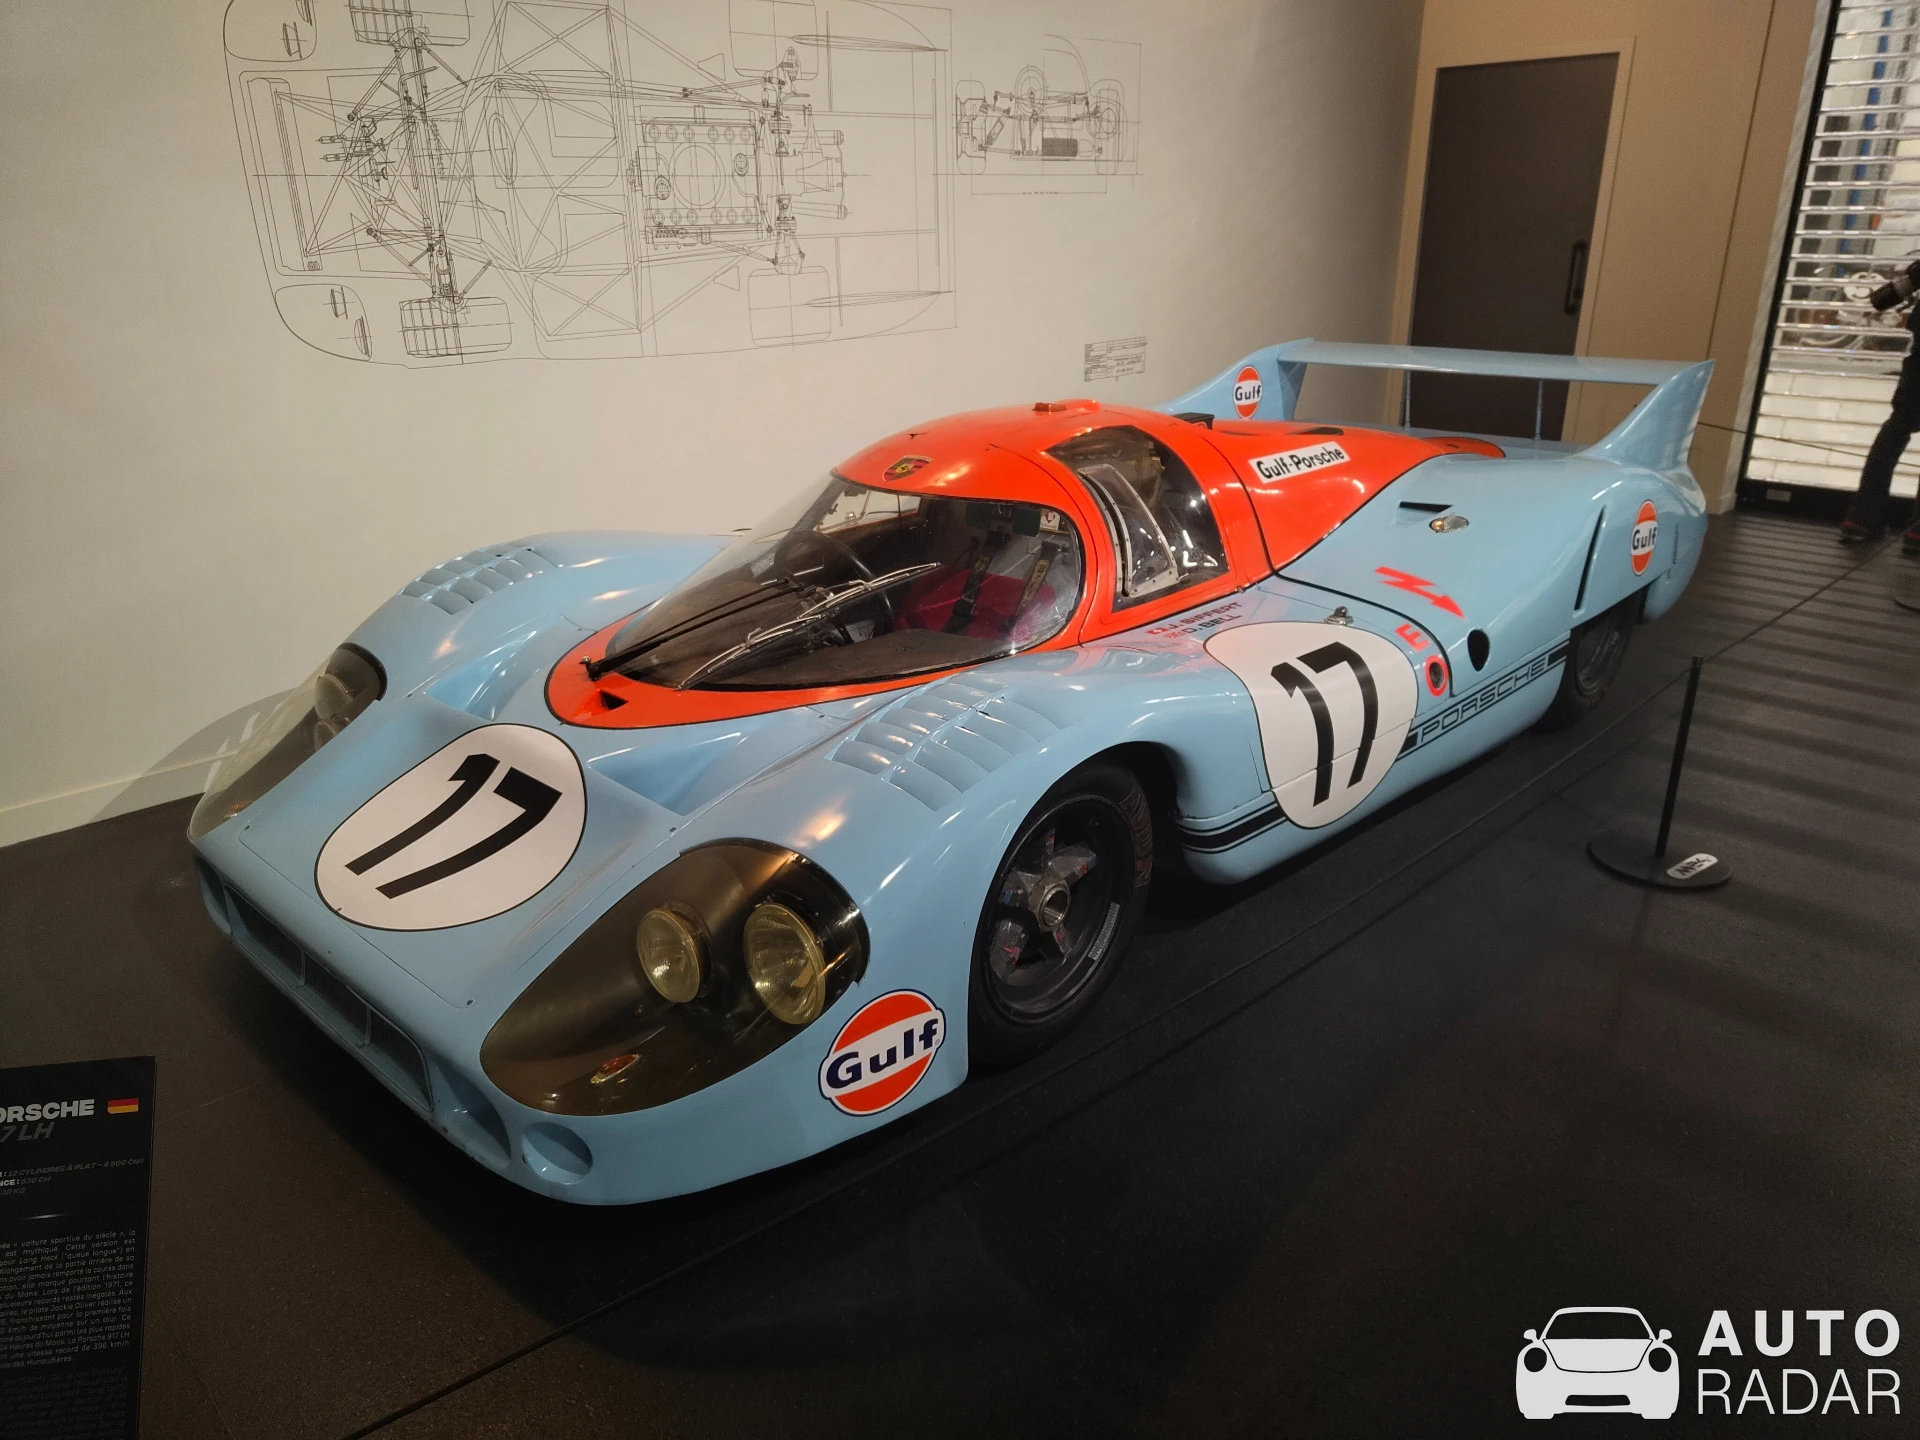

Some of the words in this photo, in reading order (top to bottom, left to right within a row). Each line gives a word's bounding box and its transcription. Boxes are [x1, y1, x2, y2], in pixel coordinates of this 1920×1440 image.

[1234, 385, 1261, 401] Gulf
[1256, 447, 1345, 479] Gulf-Porsche
[1632, 526, 1657, 551] Gulf
[1420, 657, 1548, 743] PORSCHE
[1270, 641, 1379, 807] 17
[344, 753, 563, 900] 17
[826, 1018, 939, 1089] Gulf
[19, 1165, 66, 1176] CYLINDRES
[74, 1162, 97, 1171] PLAT
[21, 1238, 48, 1247] voiture
[50, 1234, 81, 1245] sportive
[92, 1238, 118, 1248] version
[0, 1262, 42, 1274] llongement
[93, 1265, 116, 1273] course
